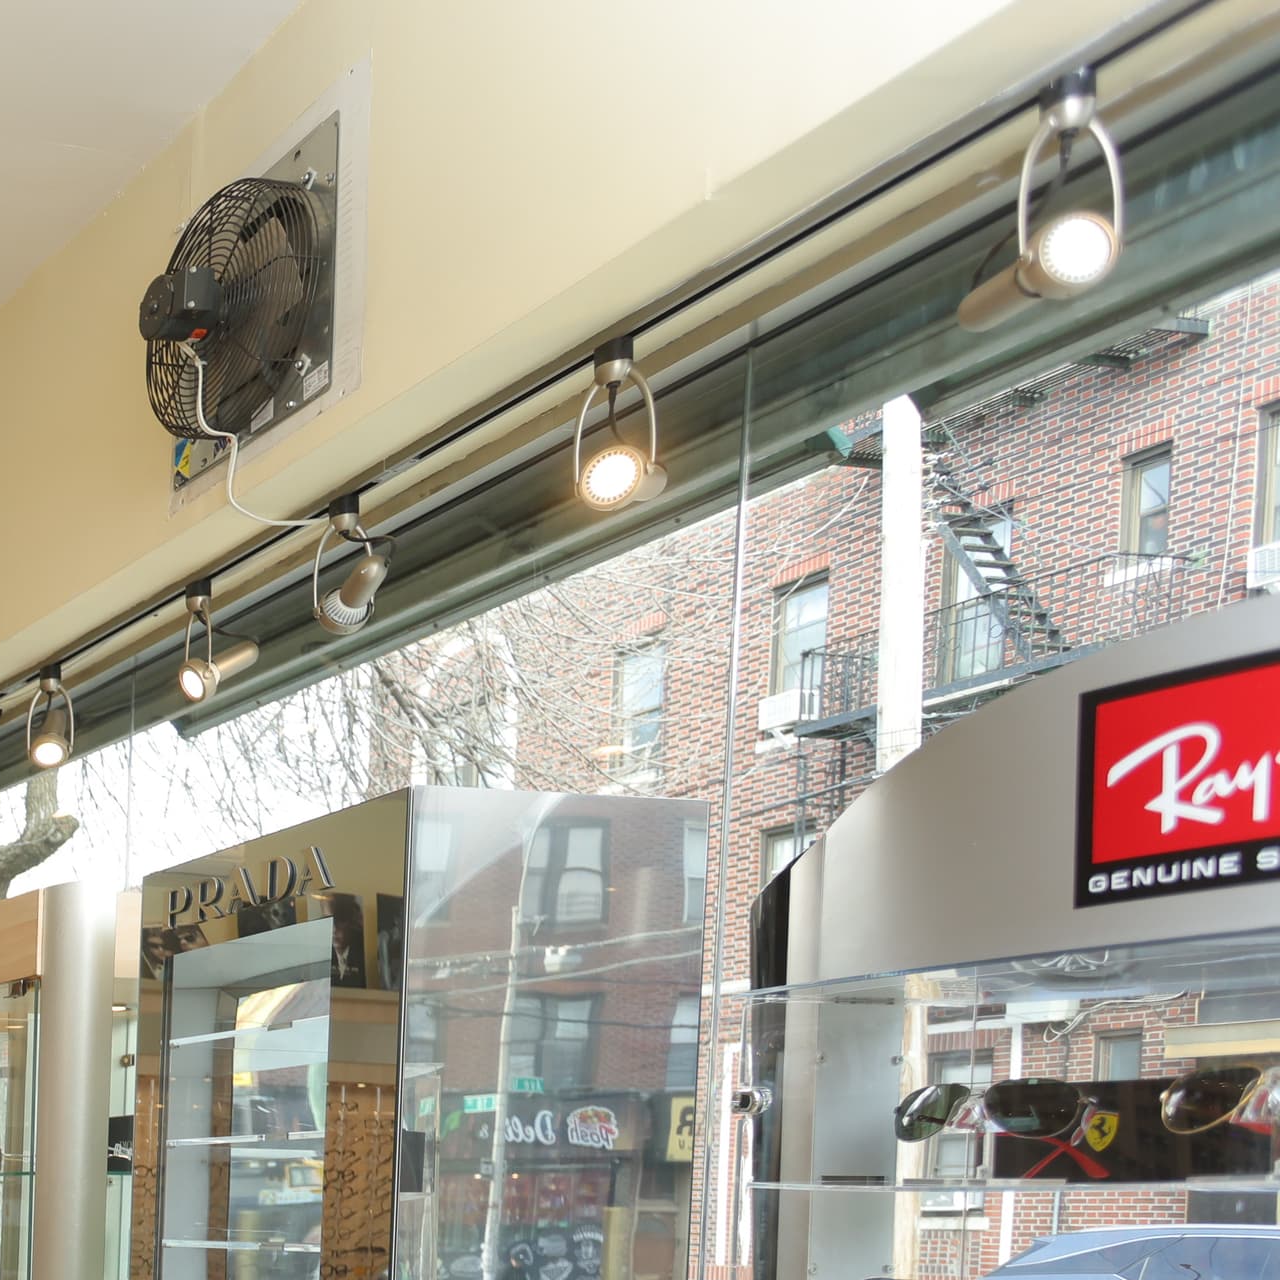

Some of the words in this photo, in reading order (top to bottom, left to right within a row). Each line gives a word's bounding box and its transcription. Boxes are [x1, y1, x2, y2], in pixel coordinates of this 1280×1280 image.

[1107, 722, 1280, 835] Ray
[168, 845, 336, 929] PRADA
[1088, 851, 1242, 893] GENUINE
